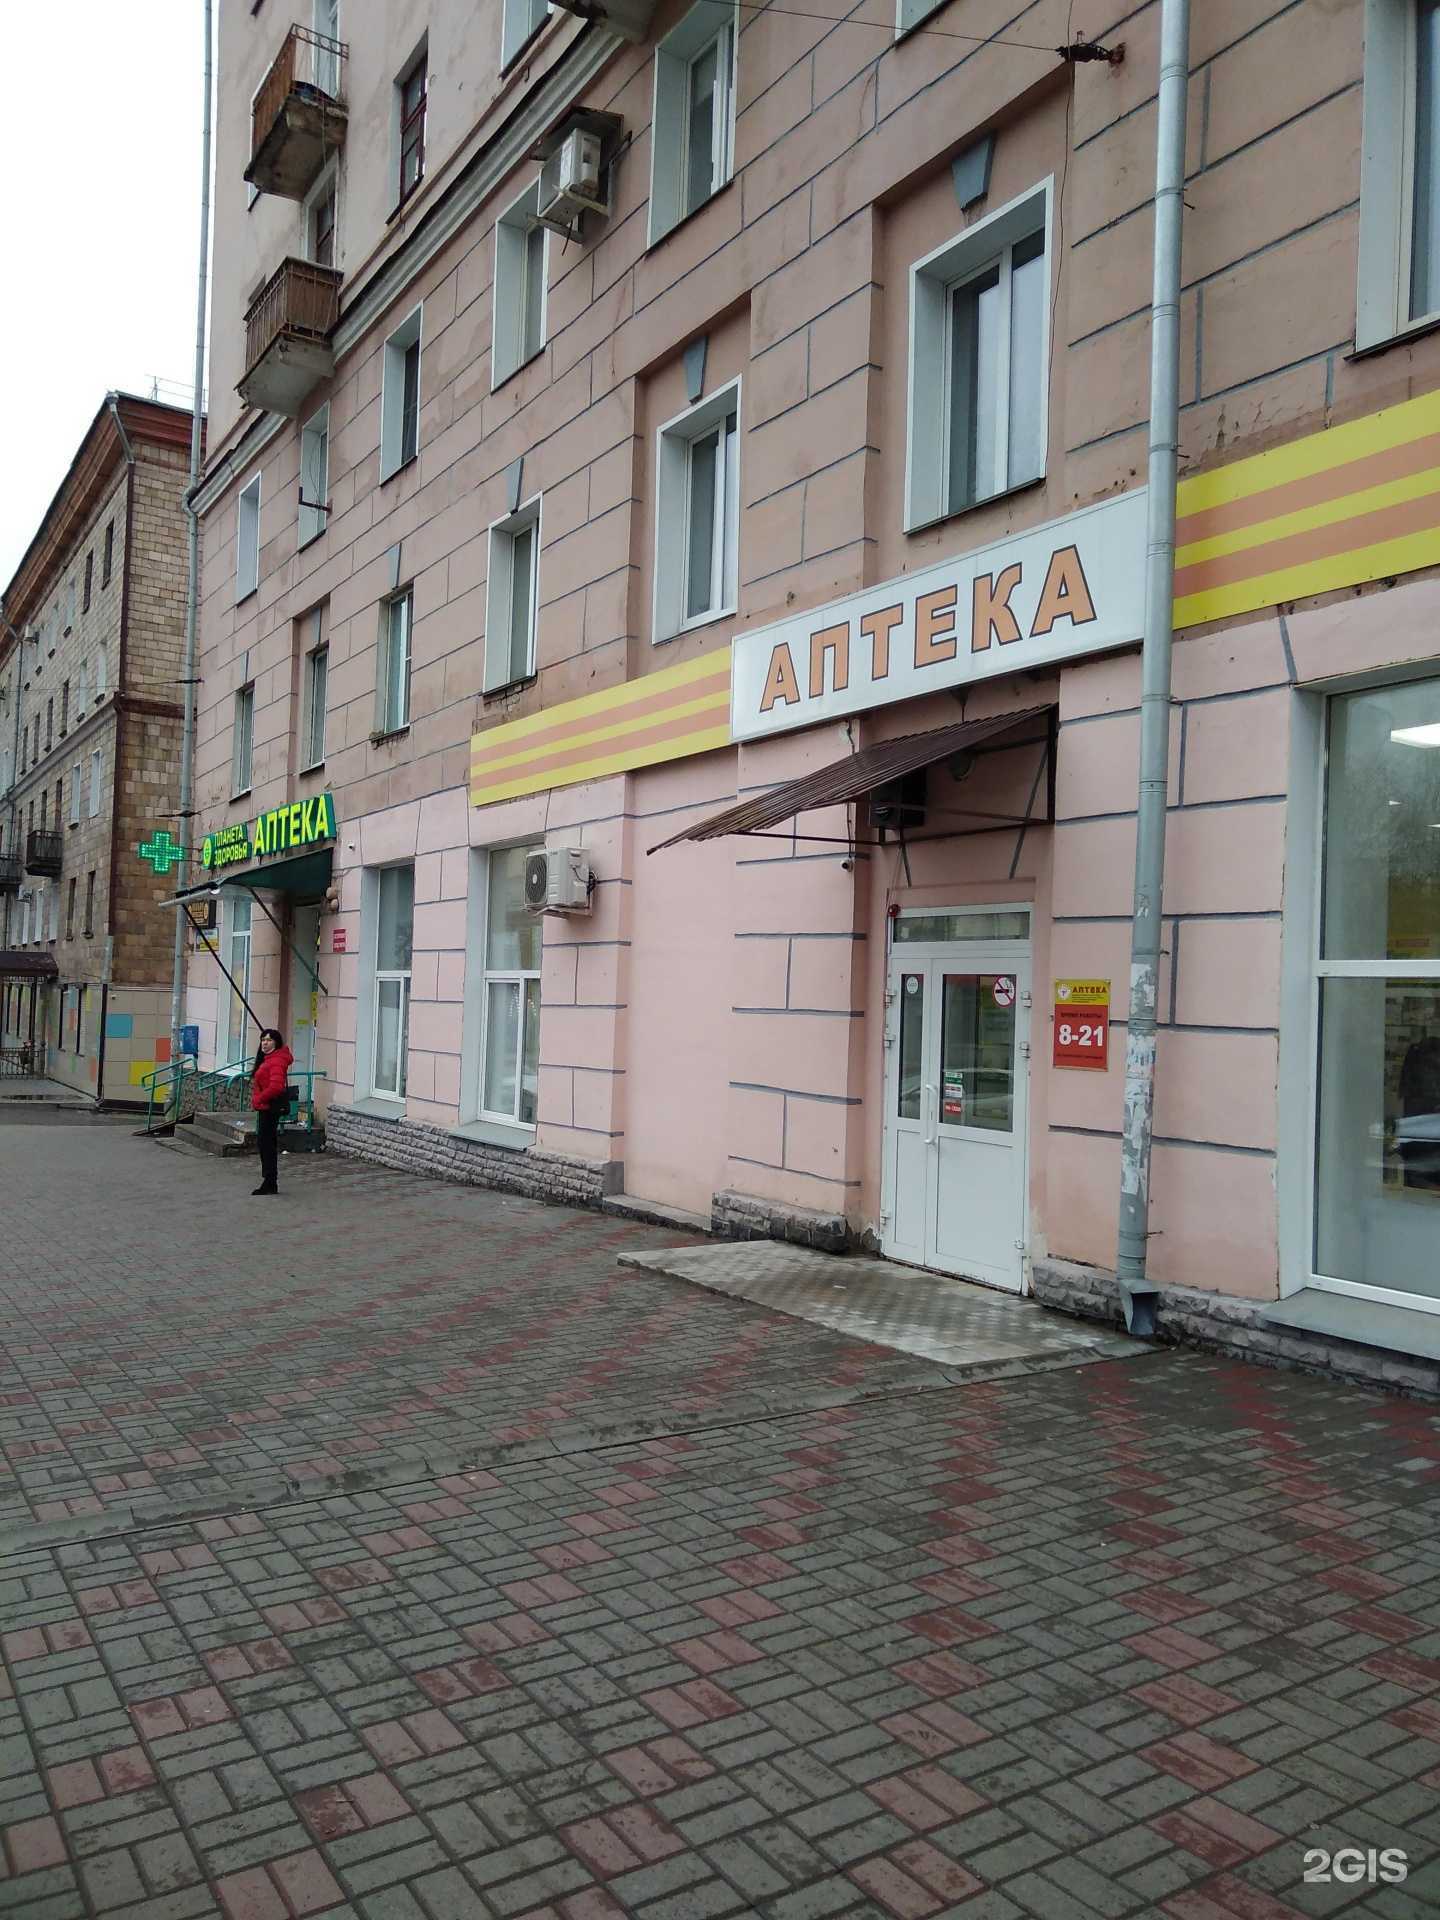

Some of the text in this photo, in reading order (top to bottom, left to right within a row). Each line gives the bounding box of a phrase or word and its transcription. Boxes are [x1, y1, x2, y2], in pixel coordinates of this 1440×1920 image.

[759, 543, 1098, 714] АПТЕКА
[214, 824, 244, 847] ПЛАНЕТА
[253, 793, 330, 857] АПТЕКА
[214, 841, 248, 866] ЗДОРОВЬЯ
[1072, 985, 1107, 994] АПТЕКА
[1058, 1024, 1104, 1047] 8-21
